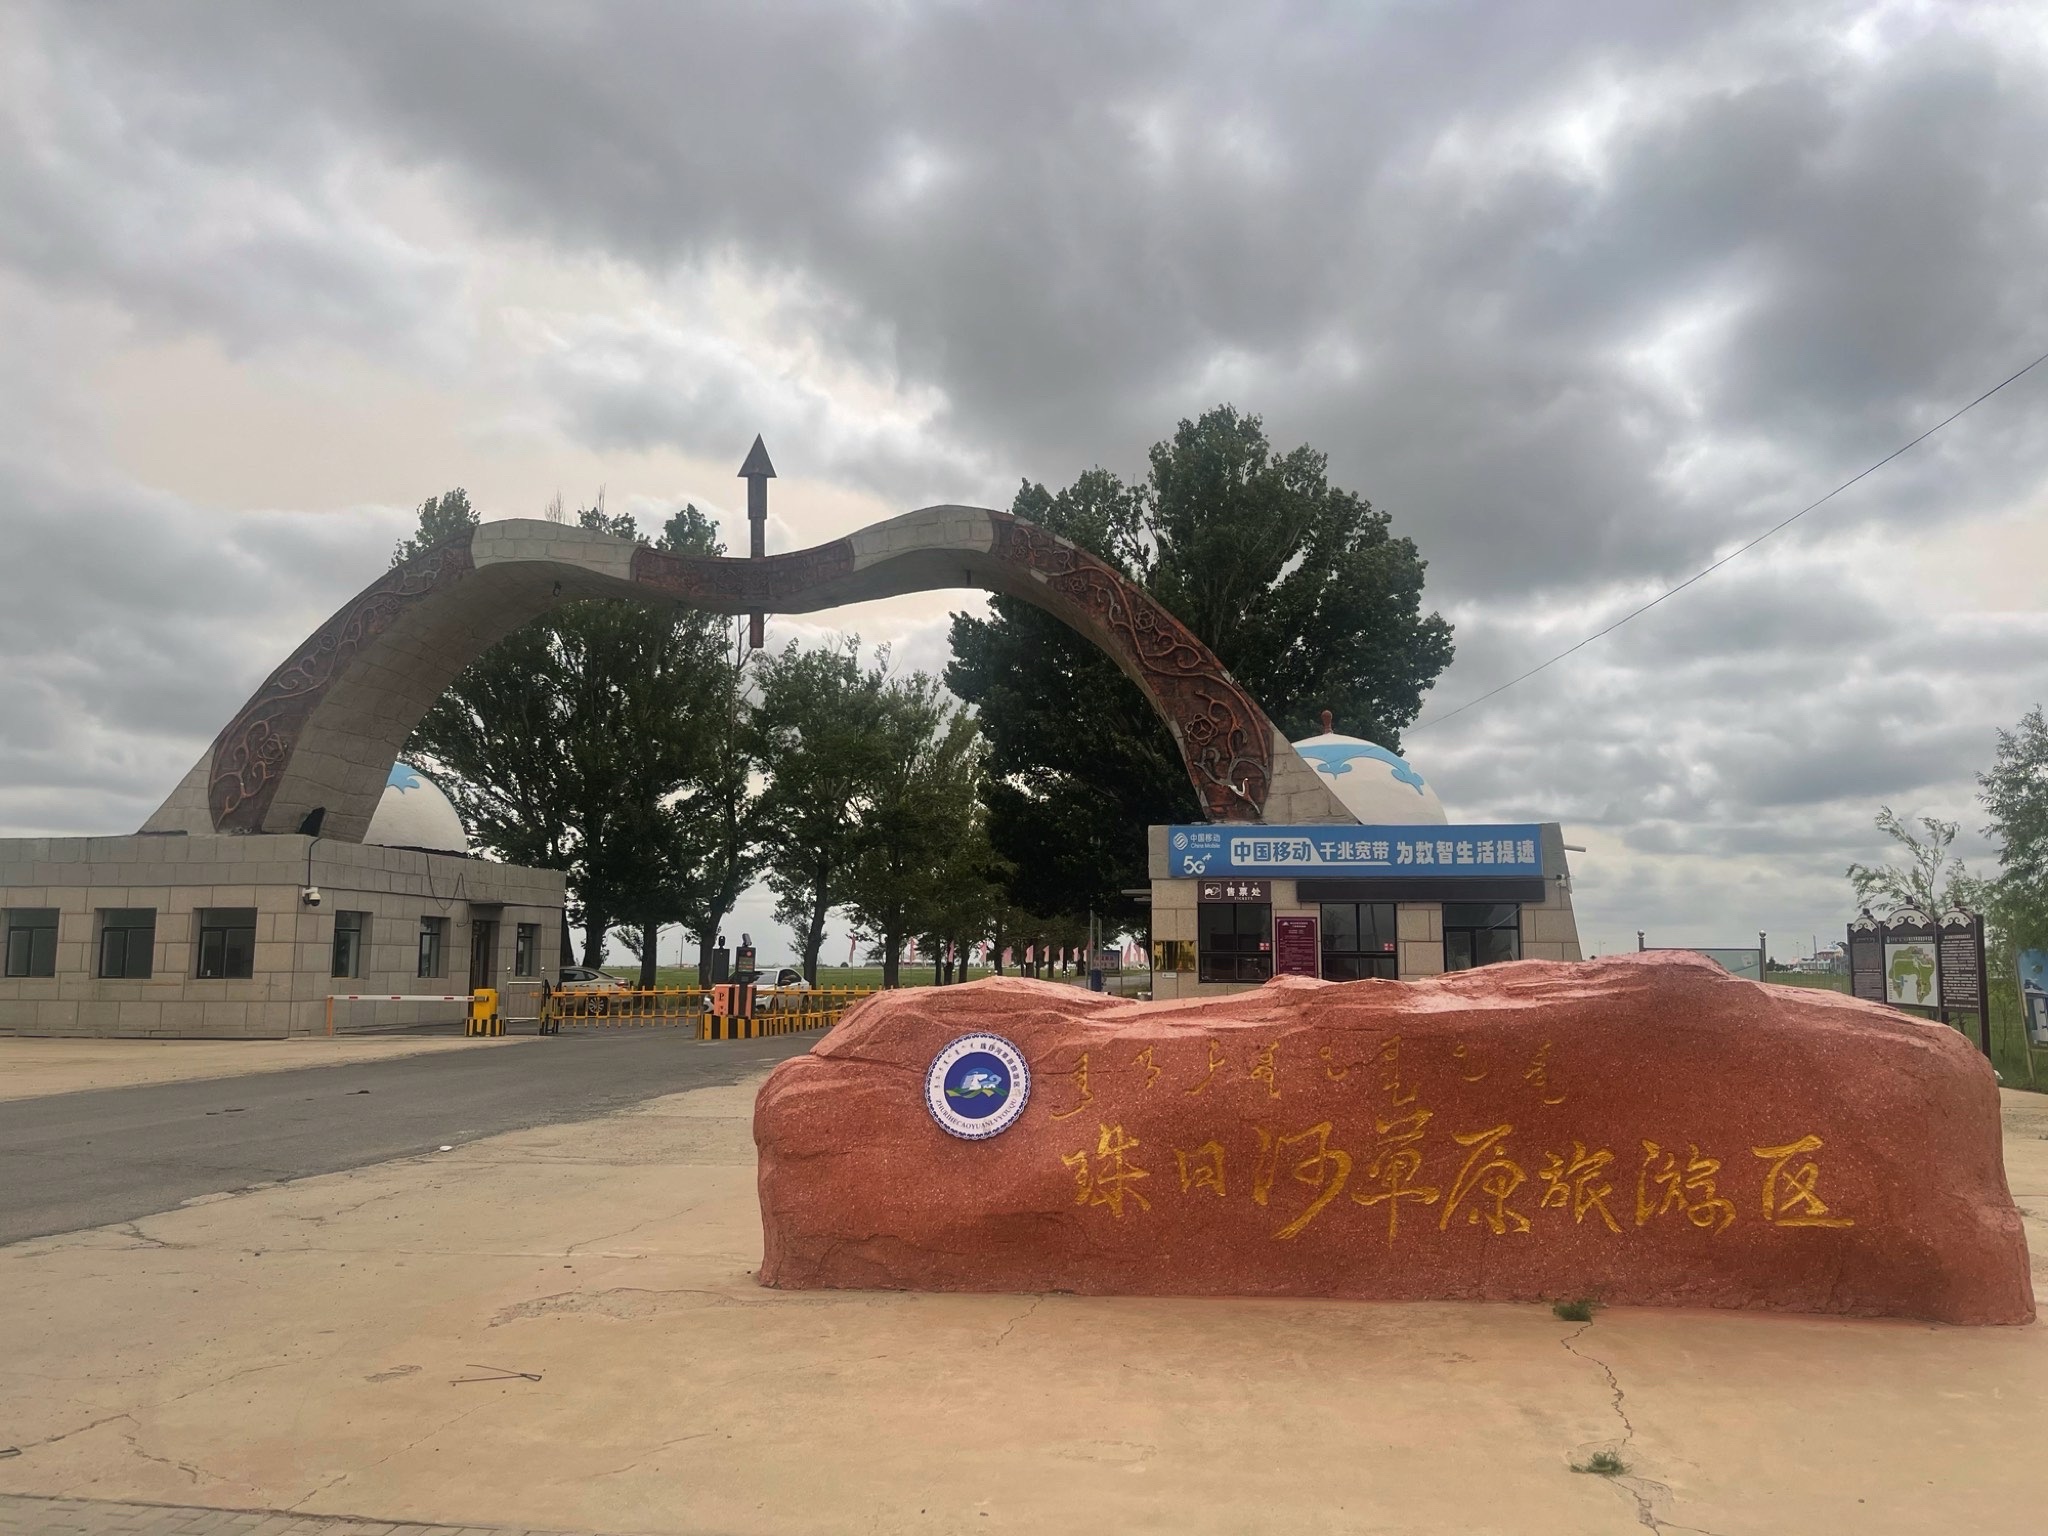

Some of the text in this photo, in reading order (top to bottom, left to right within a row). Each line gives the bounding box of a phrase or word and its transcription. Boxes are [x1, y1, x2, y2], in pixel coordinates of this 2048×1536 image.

[1190, 833, 1221, 842] 中国移动
[1234, 839, 1536, 865] 中国移动 千兆宽带 为数智生活提速
[1226, 886, 1261, 897] 售票处
[1061, 1108, 1855, 1250] 珠日河草原旅游区
